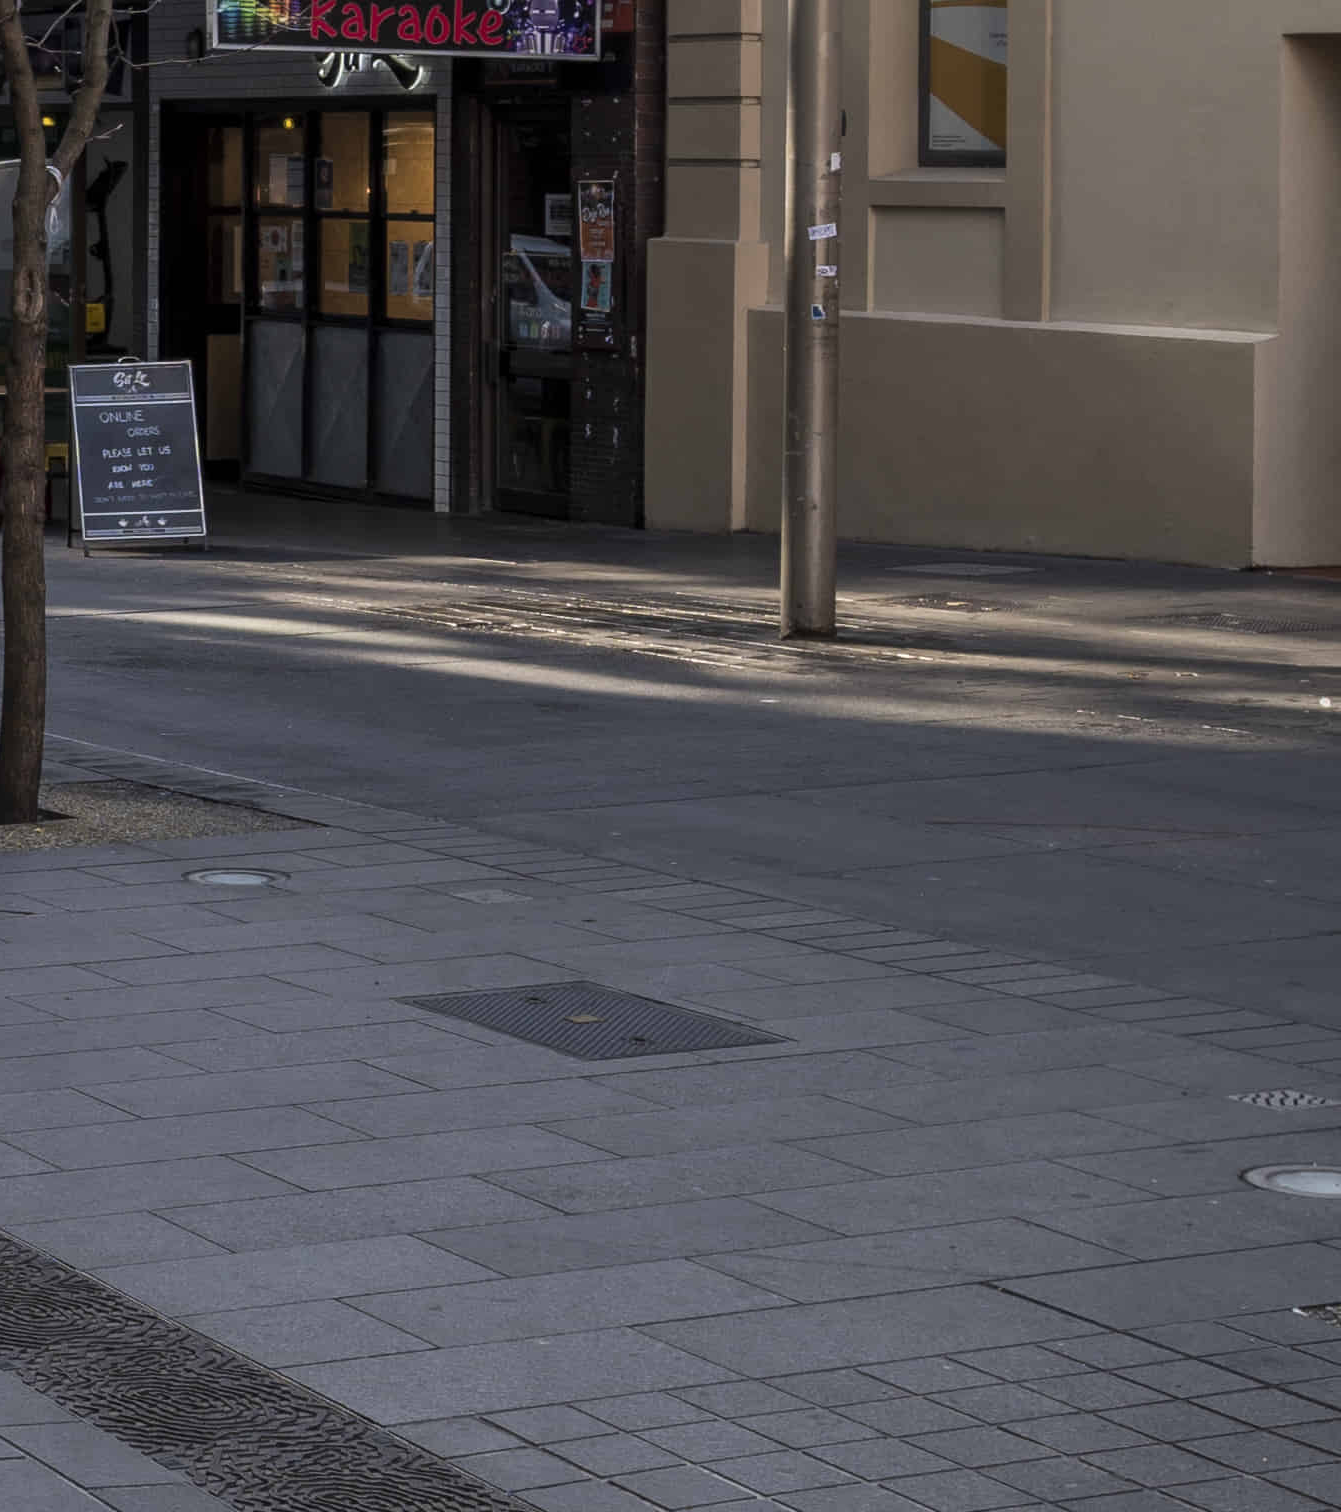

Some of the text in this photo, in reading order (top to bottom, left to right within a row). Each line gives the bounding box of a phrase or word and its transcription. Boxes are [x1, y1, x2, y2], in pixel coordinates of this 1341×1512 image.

[99, 410, 146, 424] ONLINE
[127, 426, 160, 438] ORDERS
[102, 445, 171, 459] PLEASE LET US
[139, 463, 155, 472] YOU
[107, 481, 124, 490] ARE
